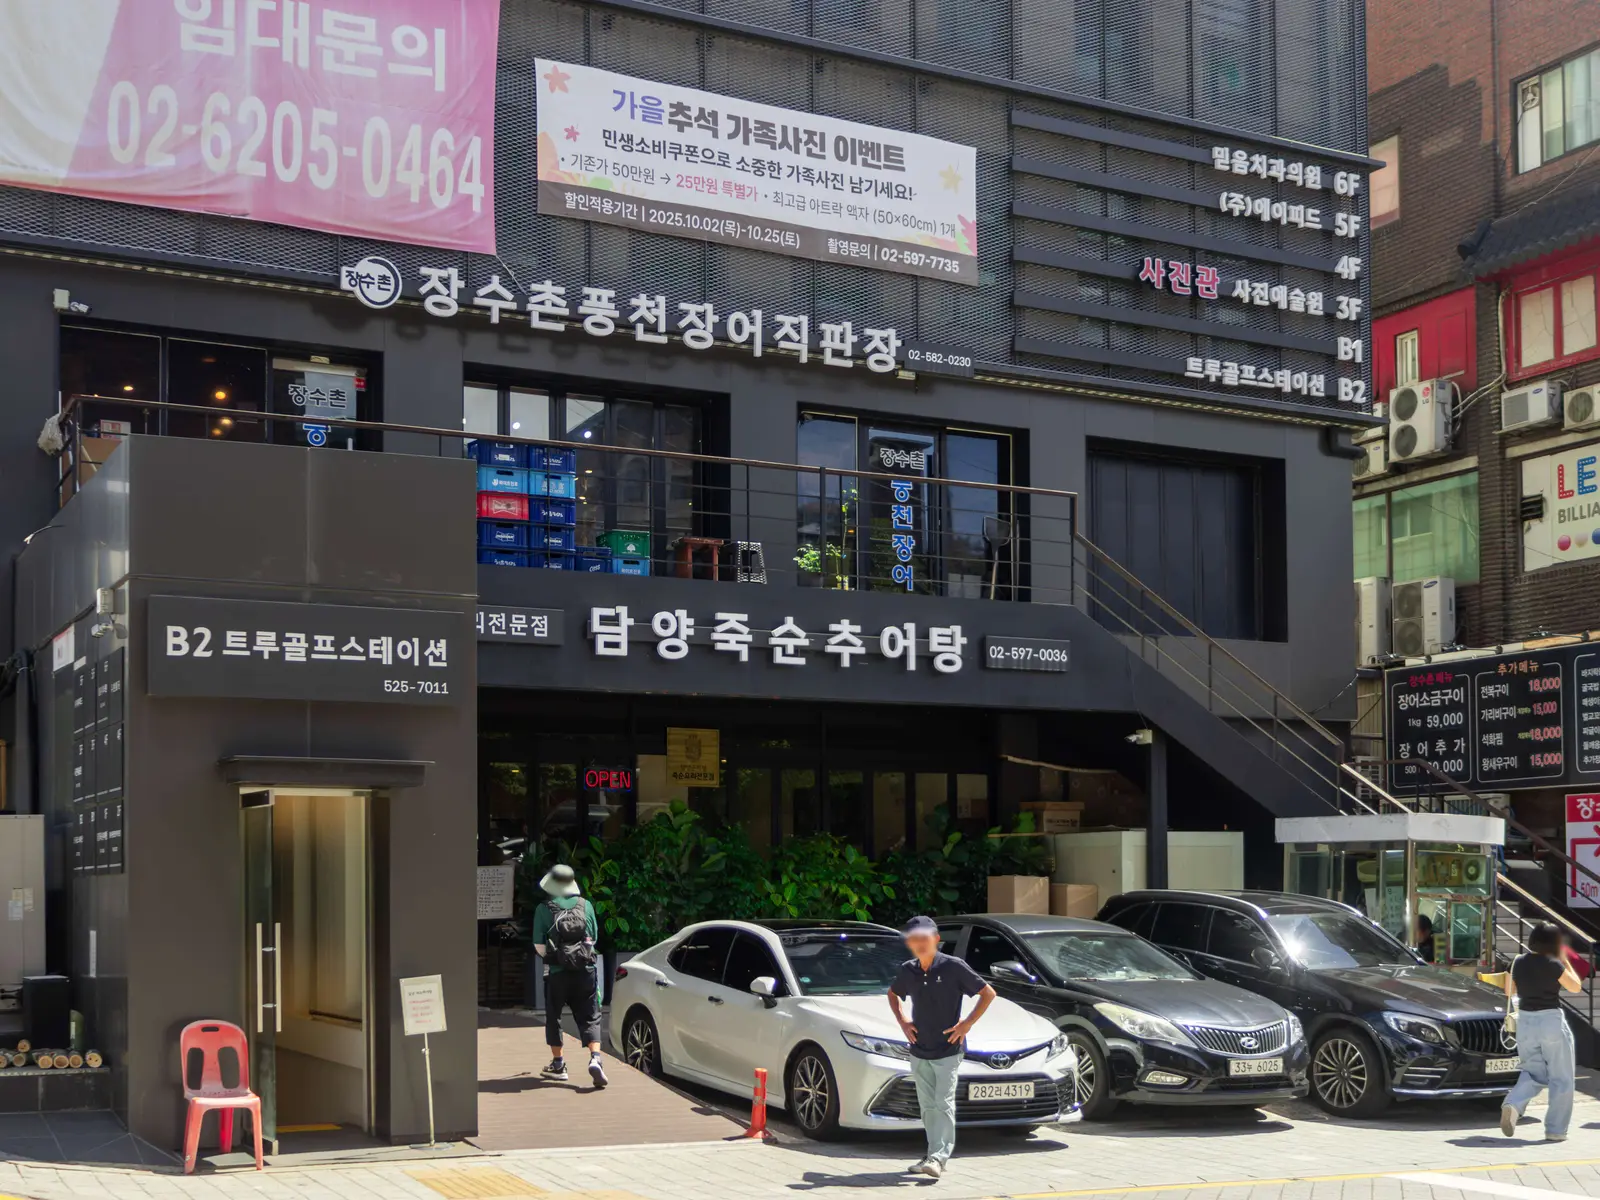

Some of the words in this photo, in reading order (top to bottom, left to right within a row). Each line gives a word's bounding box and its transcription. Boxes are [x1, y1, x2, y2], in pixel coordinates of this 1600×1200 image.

[174, 0, 447, 92] 임대문의
[106, 80, 485, 213] 02-6205-0464
[726, 113, 827, 160] 가족사진
[833, 135, 906, 172] 이벤트
[602, 128, 732, 169] 민생소비쿠폰으로
[735, 156, 783, 180] 소중한
[786, 165, 844, 191] 가족사진
[849, 176, 913, 201] 남기세요!
[1212, 146, 1322, 190] 믿음치과의원
[1333, 171, 1360, 197] 6F
[570, 153, 608, 176] 기존가
[612, 162, 655, 185] 50만원
[675, 174, 718, 195] 25만원
[722, 181, 758, 202] 특별가
[772, 191, 807, 211] 최고급
[809, 198, 843, 218] 아트락
[846, 204, 870, 222] 액자
[940, 222, 956, 238] 1개
[564, 191, 638, 220] 할인적용기간
[649, 209, 800, 249] 2025.10.02(목)-10.25(토)
[827, 238, 871, 260] 촬영문의
[880, 247, 960, 273] 02-597-7735
[1334, 212, 1361, 238] 5F
[1139, 257, 1220, 299] 사진관
[1334, 255, 1361, 280] 4F
[345, 270, 392, 293] 장수촌
[1231, 278, 1324, 316] 사진예술원
[1335, 295, 1362, 321] 3F
[418, 266, 901, 373] 장수촌풍천장어직판장
[907, 348, 971, 367] 02-582-0230
[1337, 336, 1363, 363] B1
[1184, 356, 1325, 397] 트루골프스테이션
[1337, 377, 1367, 404] B2
[288, 383, 348, 410] 장수촌
[880, 448, 925, 470] 장수촌
[1557, 455, 1598, 500] LE
[166, 625, 213, 658] B2
[222, 629, 448, 668] 트루골프스테이션
[591, 605, 968, 673] 담양죽순추어탕
[989, 645, 1068, 663] 02-597-0036
[383, 679, 449, 695] 525-7011
[1397, 686, 1464, 710] 장어소금구이
[1480, 683, 1509, 699] 전복구이
[1528, 677, 1561, 693] 18,000
[1407, 718, 1422, 727] 1kg
[1426, 712, 1464, 729] 59,000
[1480, 705, 1517, 721] 가리비구이
[1532, 701, 1557, 716] 15,000
[1529, 726, 1562, 741] 18,000
[1481, 755, 1518, 771] 왕새우구이
[1530, 752, 1562, 767] 15,000
[585, 770, 632, 789] OPEN
[1256, 1060, 1279, 1073] 6025
[1004, 1084, 1031, 1097] 4319
